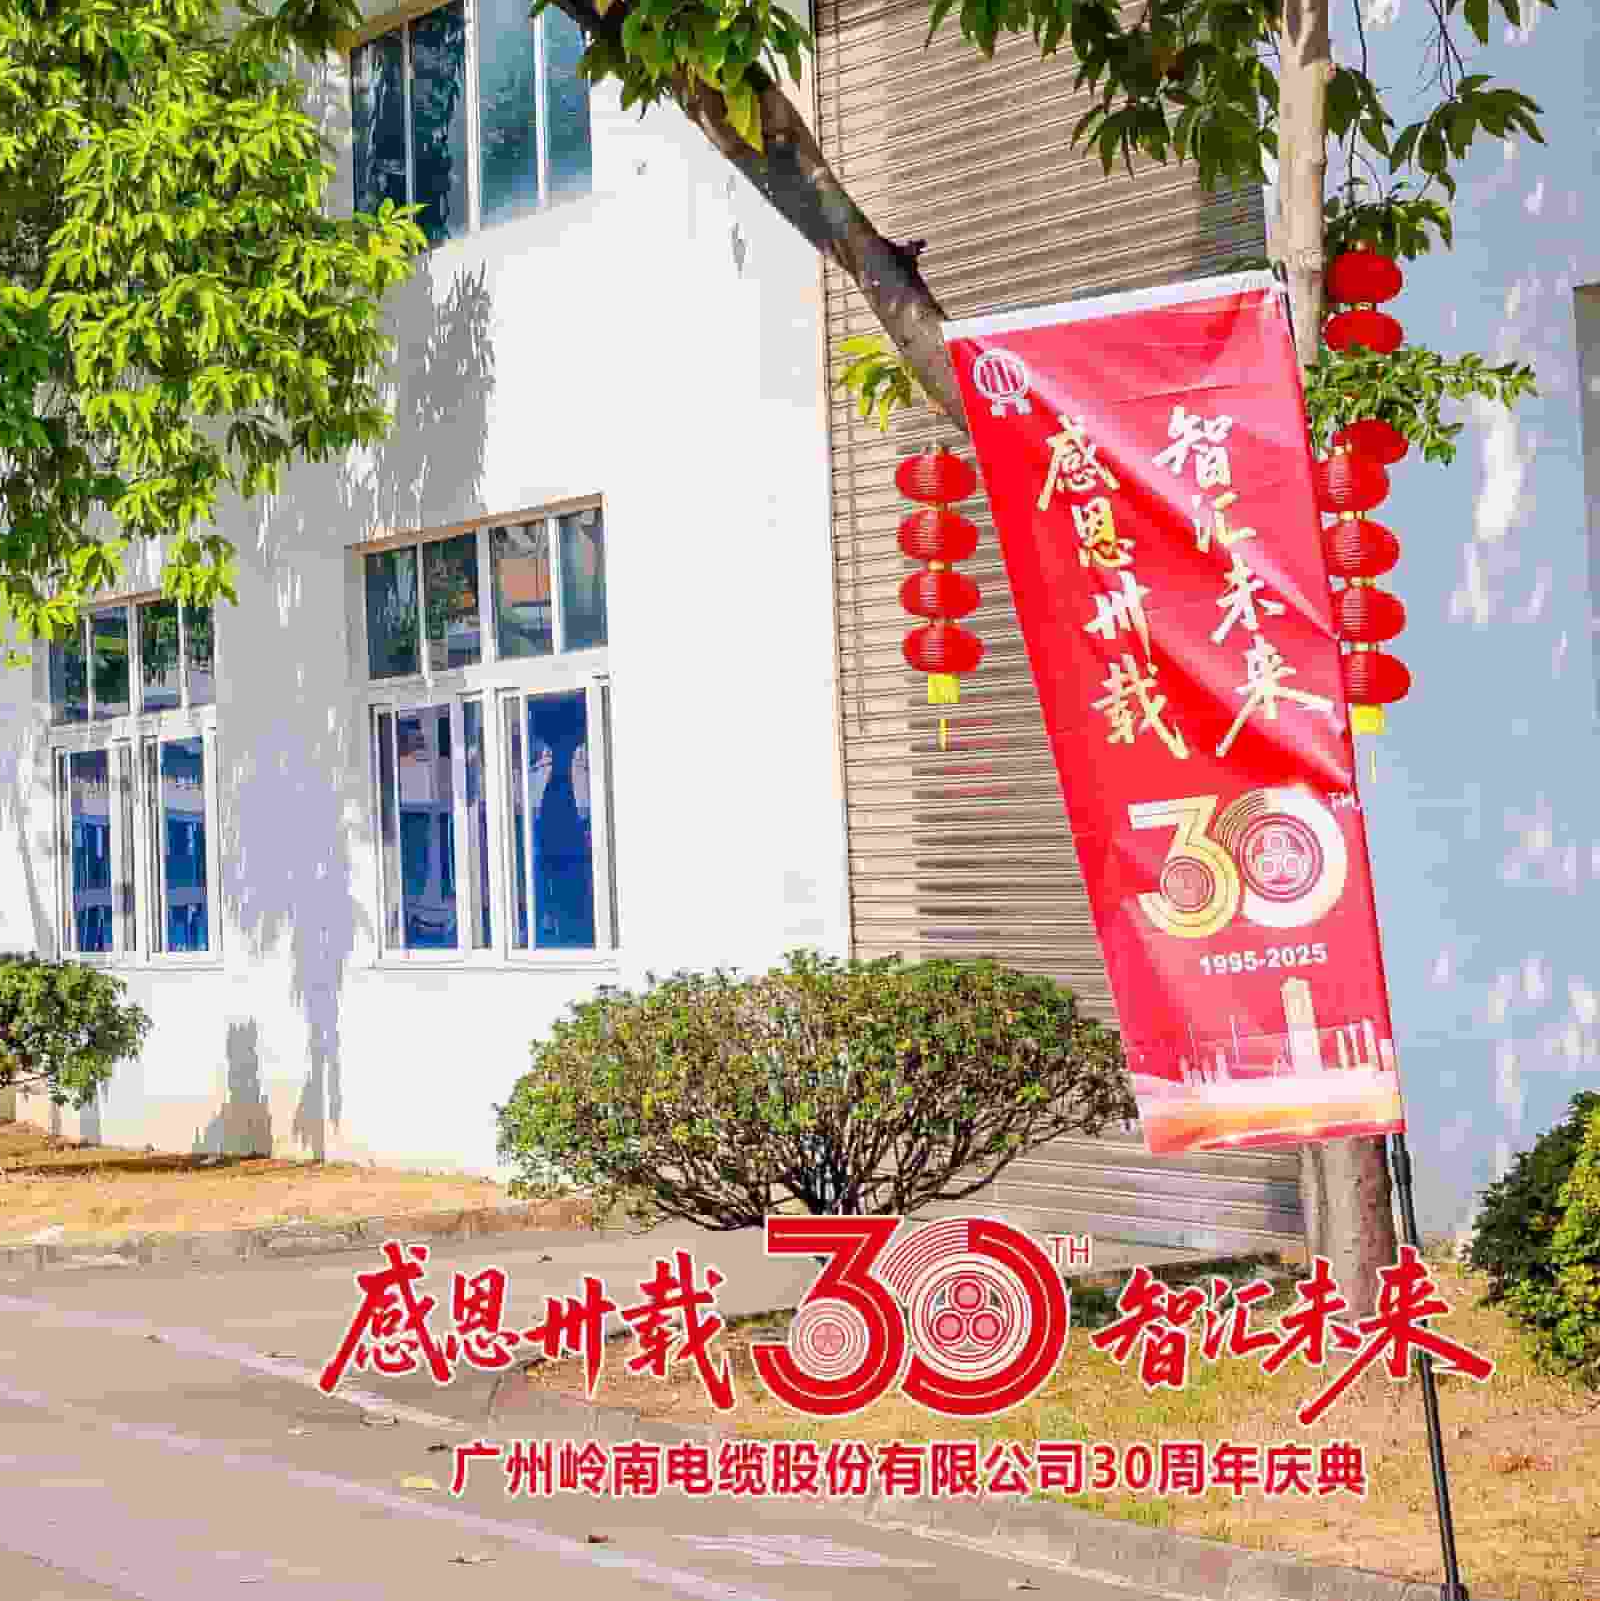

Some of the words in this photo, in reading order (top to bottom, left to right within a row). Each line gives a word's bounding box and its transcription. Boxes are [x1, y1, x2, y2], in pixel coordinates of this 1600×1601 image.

[1036, 413, 1191, 760] 感恩卅载
[1152, 405, 1345, 759] 智汇未来
[1199, 942, 1329, 976] 1995-2025
